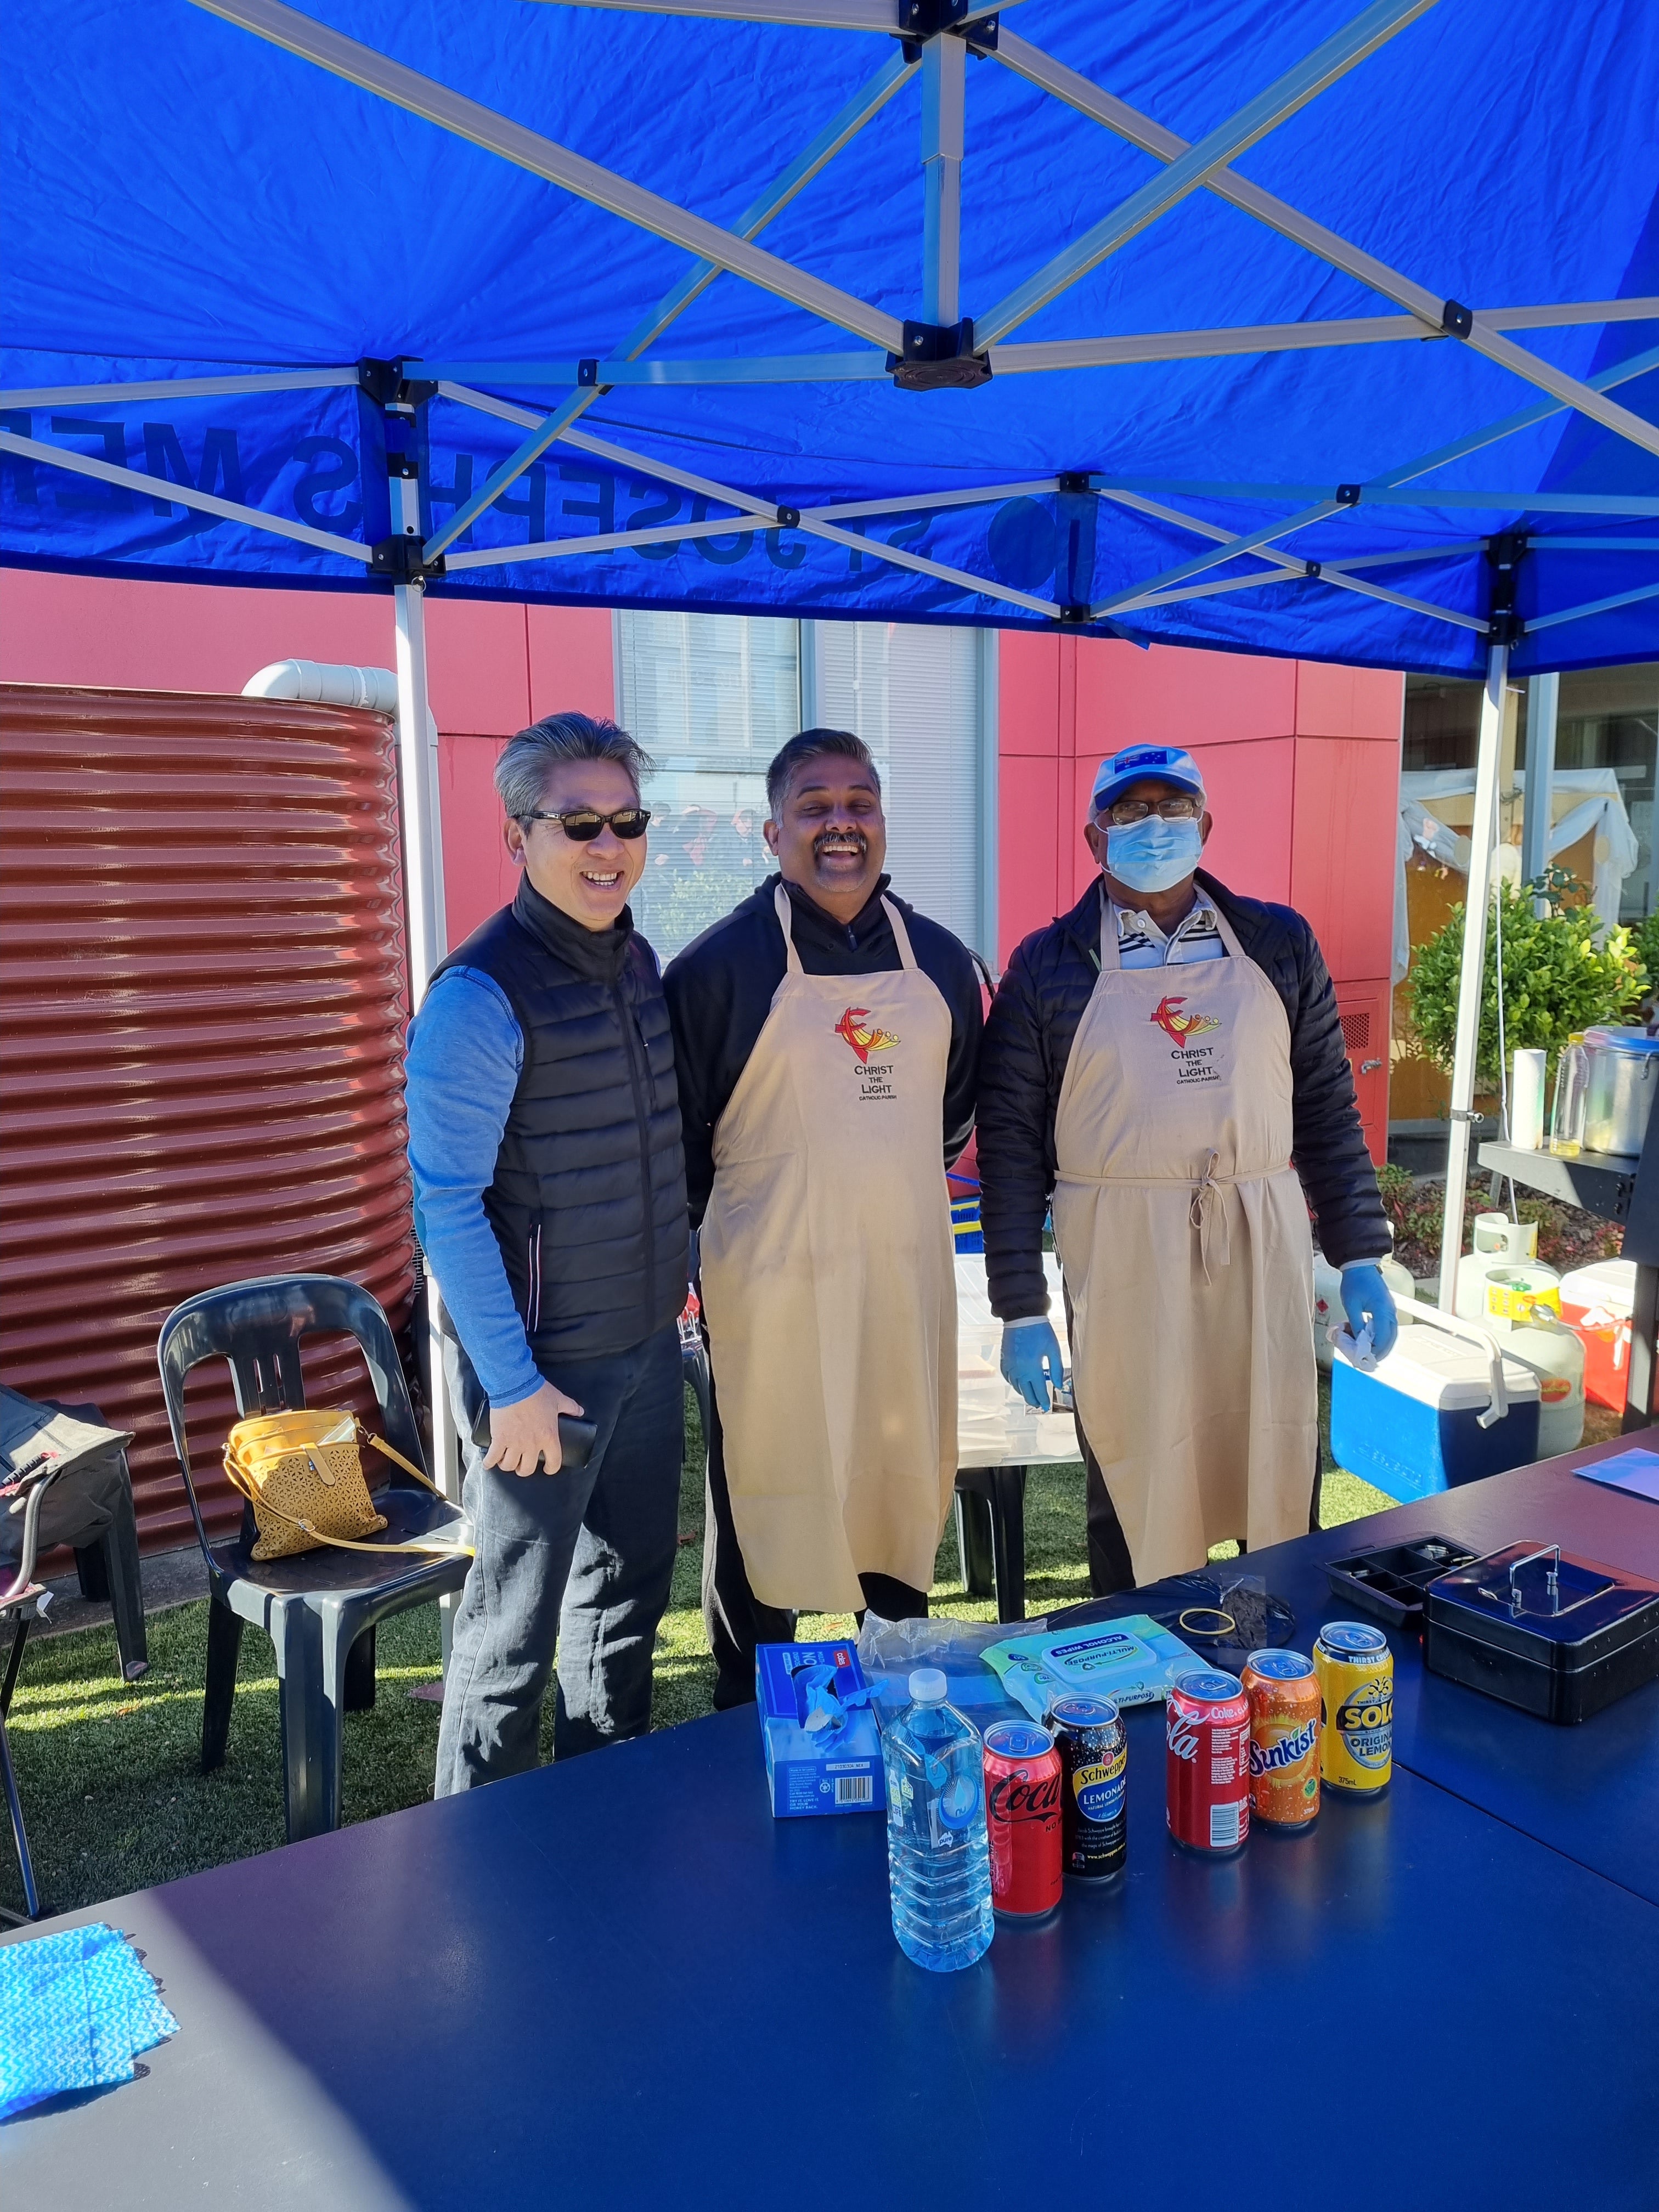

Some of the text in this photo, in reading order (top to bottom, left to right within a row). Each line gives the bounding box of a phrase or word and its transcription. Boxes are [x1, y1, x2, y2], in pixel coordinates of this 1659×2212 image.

[1171, 1047, 1214, 1059] CHRIST
[854, 1065, 894, 1075] CHRIST
[1178, 1066, 1213, 1077] LIGHT
[861, 1084, 892, 1094] LIGHT
[1055, 1635, 1122, 1655] ALCOHOL WIPES
[836, 1652, 846, 1666] coles
[1066, 1645, 1135, 1666] MULTI-PURPOSE
[1347, 1655, 1375, 1664] THIRST
[1111, 1691, 1153, 1704] ULTI-PURPOSE
[1211, 1707, 1234, 1719] Coke
[1250, 1718, 1317, 1777] Sunkist
[1083, 1774, 1127, 1805] LEMONADE
[955, 1806, 967, 1817] nu
[1045, 1819, 1057, 1832] NO
